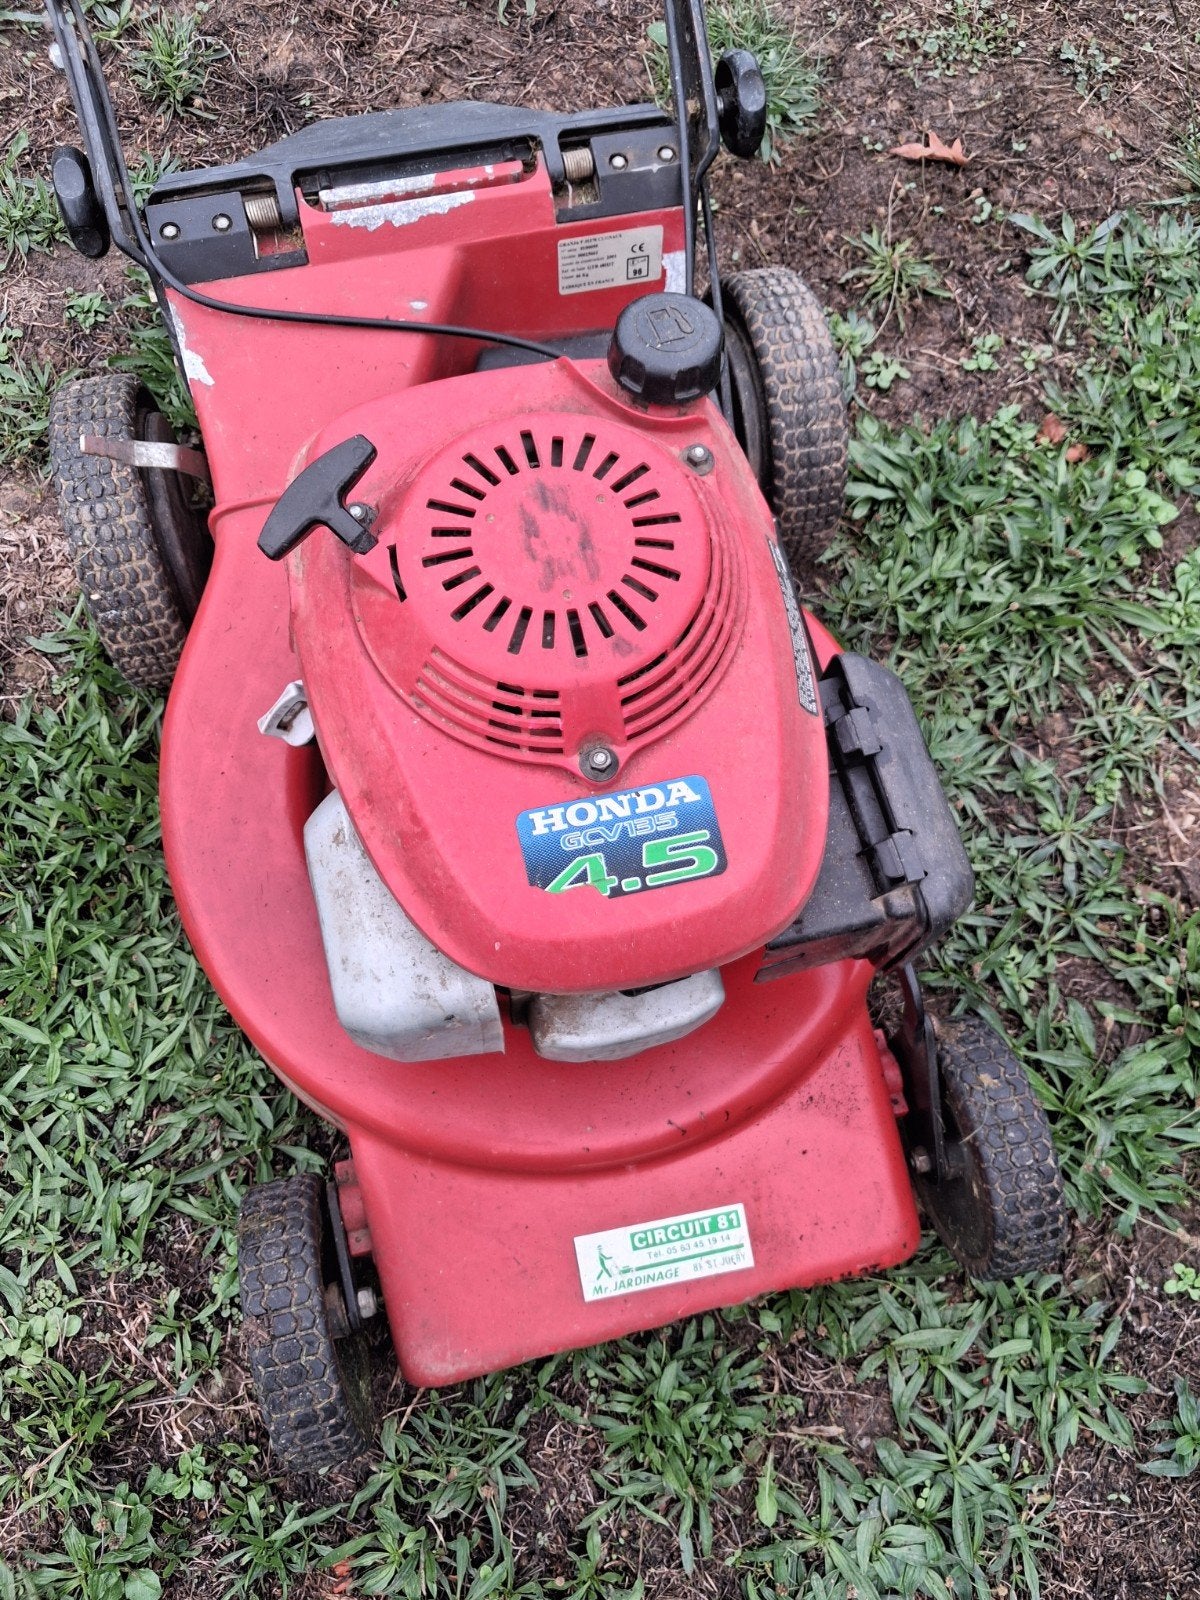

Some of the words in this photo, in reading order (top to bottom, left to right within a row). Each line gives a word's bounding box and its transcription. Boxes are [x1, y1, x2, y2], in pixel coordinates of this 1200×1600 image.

[528, 781, 701, 836] HONDA
[560, 811, 679, 851] GCV135
[544, 829, 719, 896] 4.5
[633, 1217, 712, 1248] CIRCUIT
[717, 1212, 739, 1230] 81
[666, 1246, 678, 1255] 05
[707, 1236, 718, 1245] 19
[721, 1233, 731, 1242] 14
